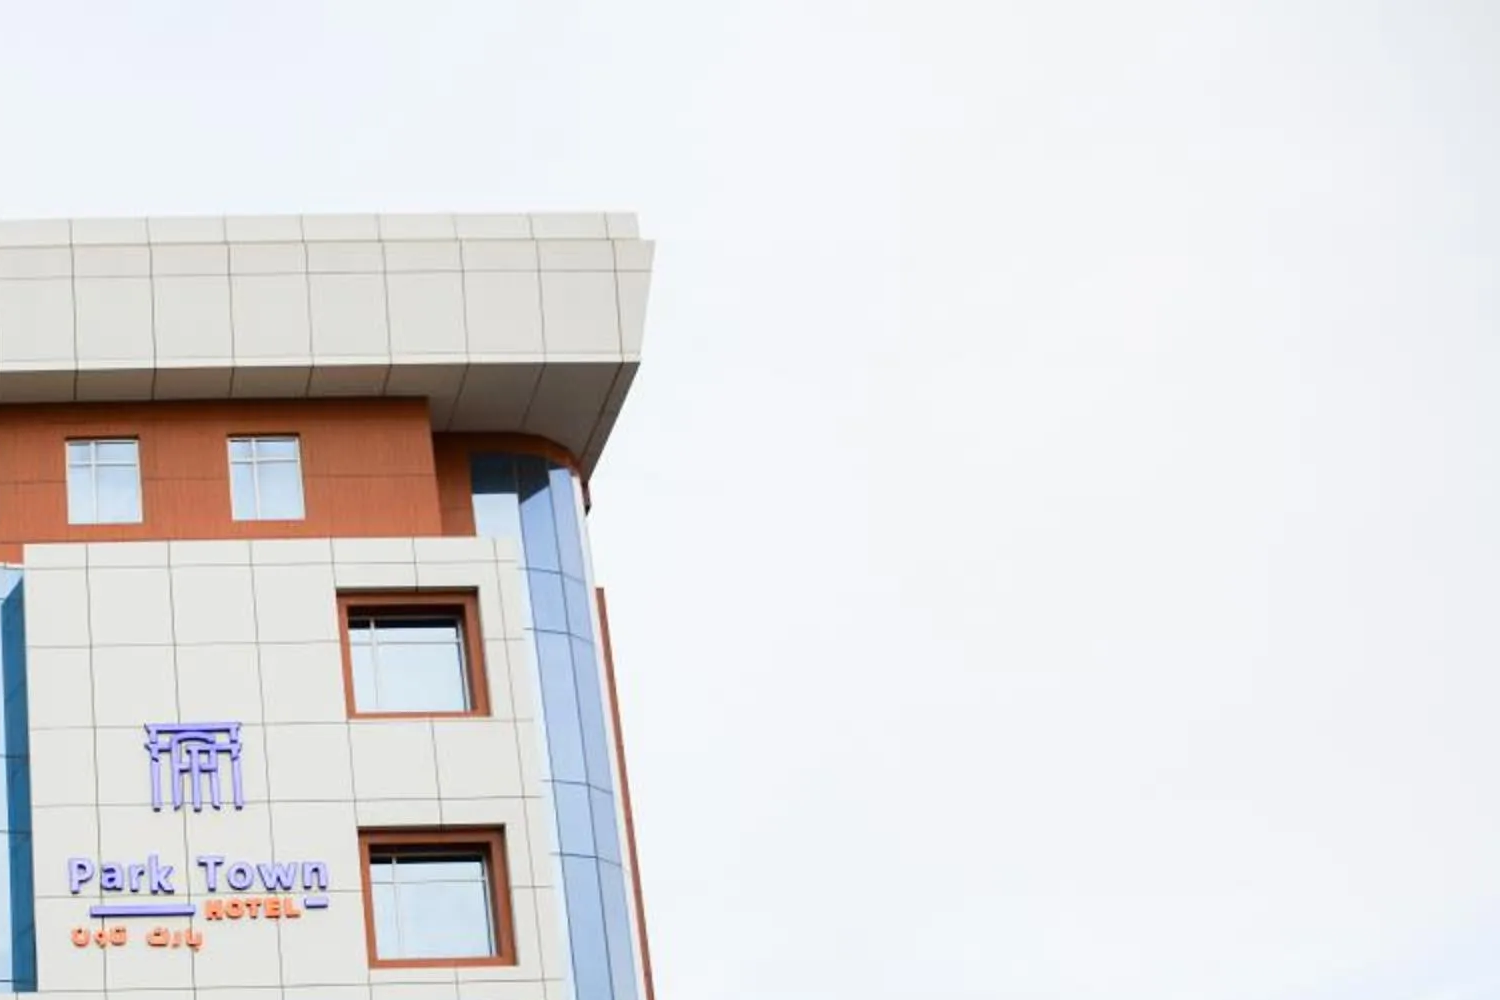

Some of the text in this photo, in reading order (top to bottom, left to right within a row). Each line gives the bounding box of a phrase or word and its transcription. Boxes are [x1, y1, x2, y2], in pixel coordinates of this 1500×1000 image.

[68, 855, 329, 895] Park Town
[205, 898, 301, 921] HOTEL
